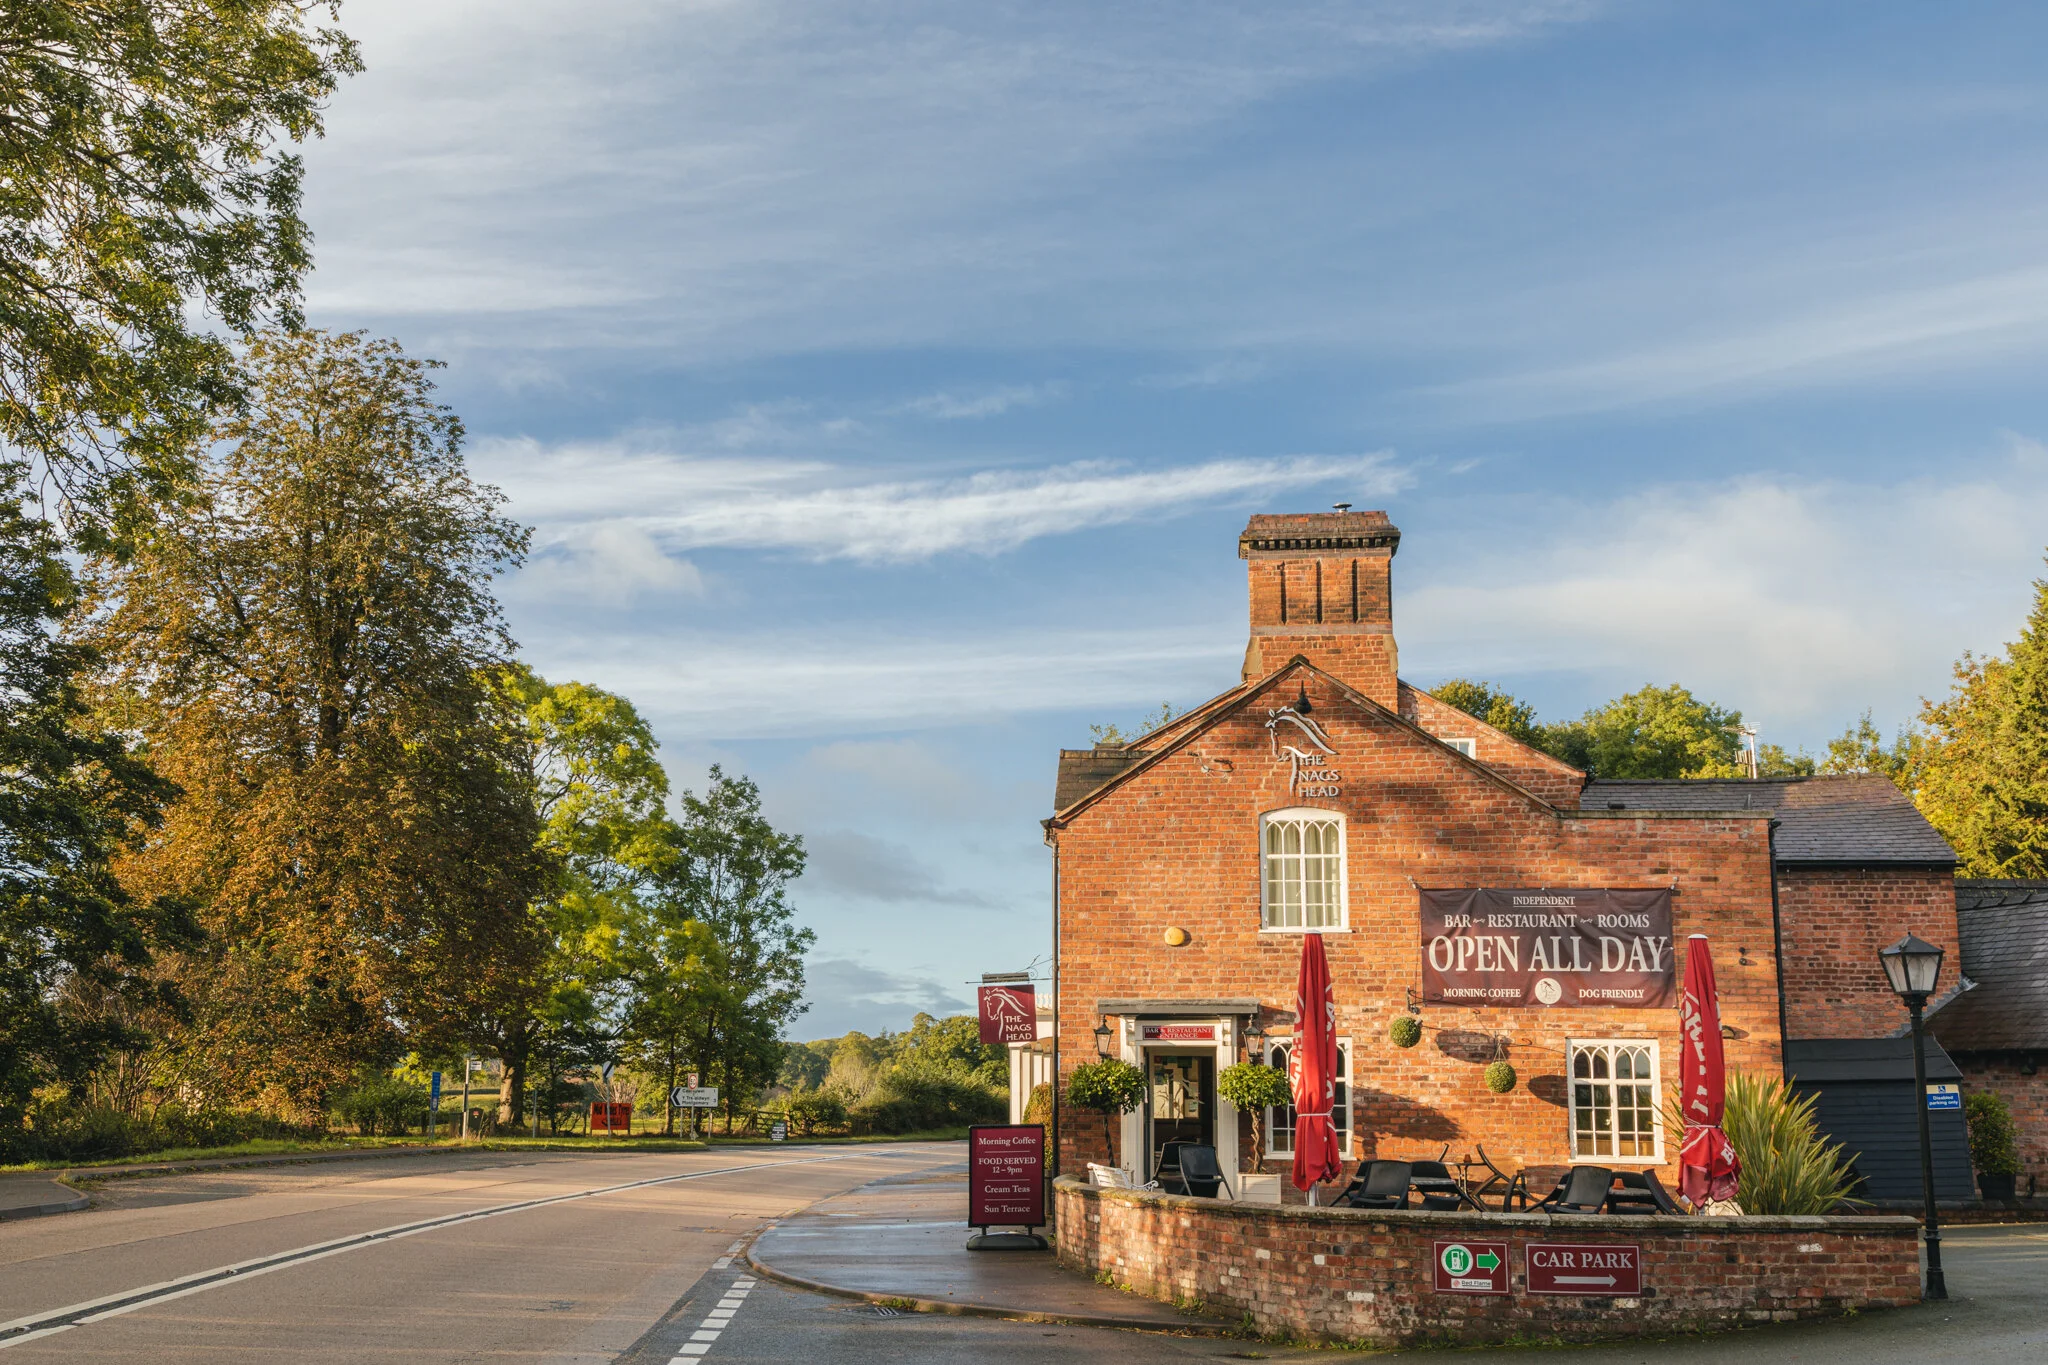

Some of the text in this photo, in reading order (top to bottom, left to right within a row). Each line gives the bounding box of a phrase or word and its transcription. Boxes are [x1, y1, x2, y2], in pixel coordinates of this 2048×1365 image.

[1298, 769, 1340, 781] NAGS
[1298, 785, 1339, 797] HEAD
[1512, 896, 1576, 905] INDEPENDENT
[1444, 914, 1650, 928] BAR RESTAURANT ROOMS
[1428, 935, 1668, 973] OPEN ALL DAY
[1443, 988, 1521, 998] MORNING COFFEE
[1579, 988, 1645, 999] DOG FRIENDLY
[1004, 1015, 1022, 1023] THE
[1005, 1023, 1032, 1032] NAGS
[1006, 1032, 1032, 1041] HEAD
[978, 1136, 1036, 1147] Morning Coffee
[1006, 1166, 1022, 1175] 9pm
[984, 1185, 1030, 1193] Cream Teas
[984, 1205, 1030, 1213] Sun Terrace
[1533, 1251, 1634, 1269] CAR PARK
